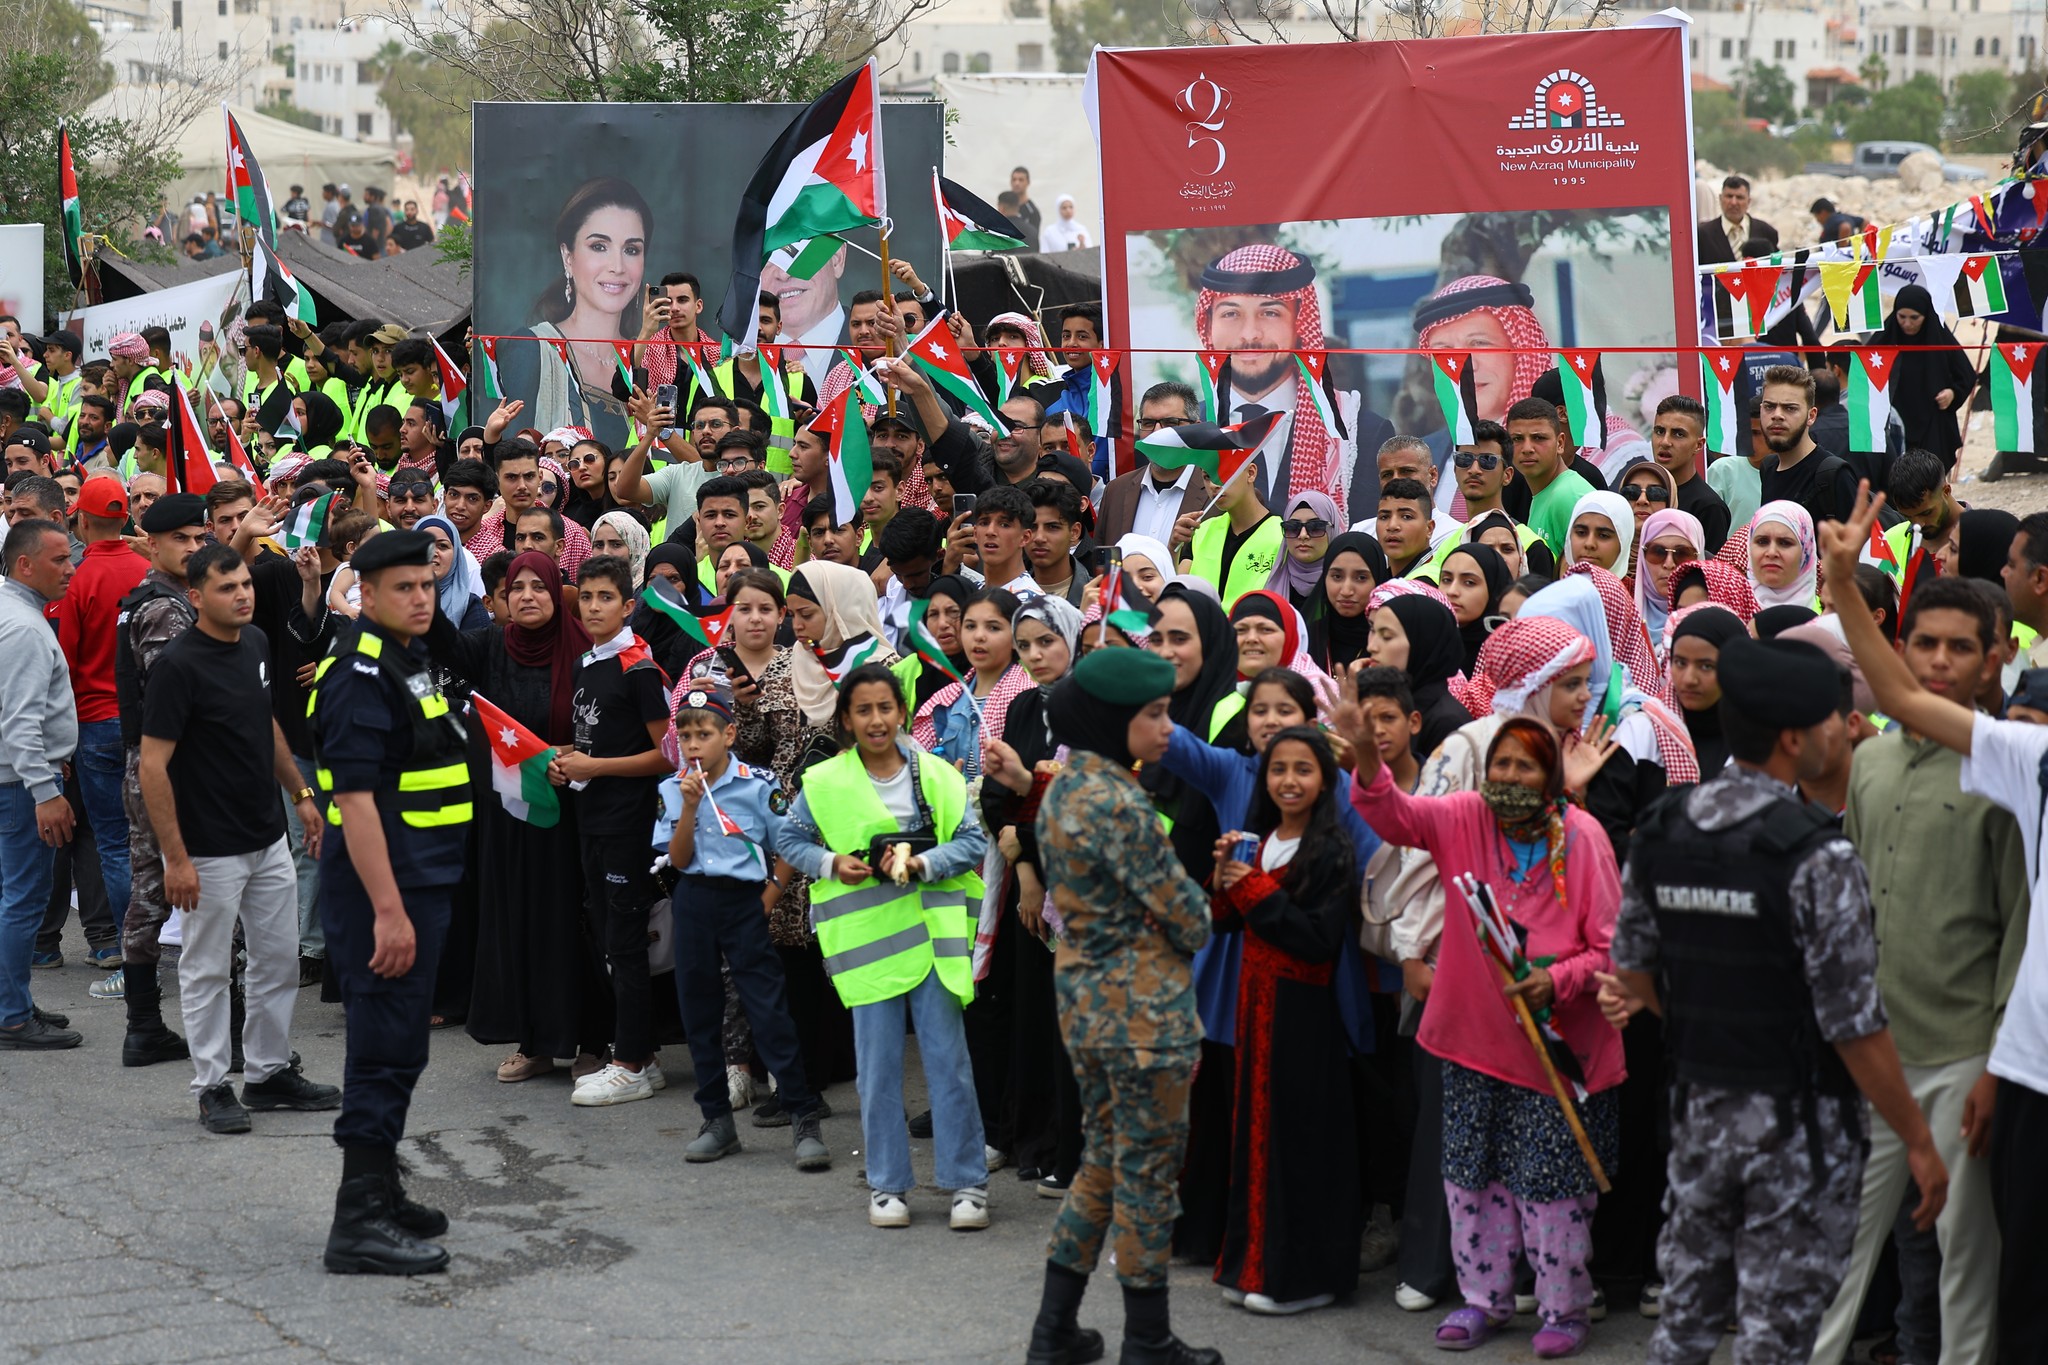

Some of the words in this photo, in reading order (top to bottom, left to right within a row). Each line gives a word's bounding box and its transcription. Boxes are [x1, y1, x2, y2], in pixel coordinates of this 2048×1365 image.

[1542, 132, 1603, 155] الأزرق
[1605, 140, 1640, 155] بلدية
[1496, 144, 1542, 158] الجديدة
[1500, 161, 1527, 172] New
[1530, 160, 1565, 172] Azraq
[1567, 158, 1636, 170] Municipality
[1553, 176, 1586, 186] 1995
